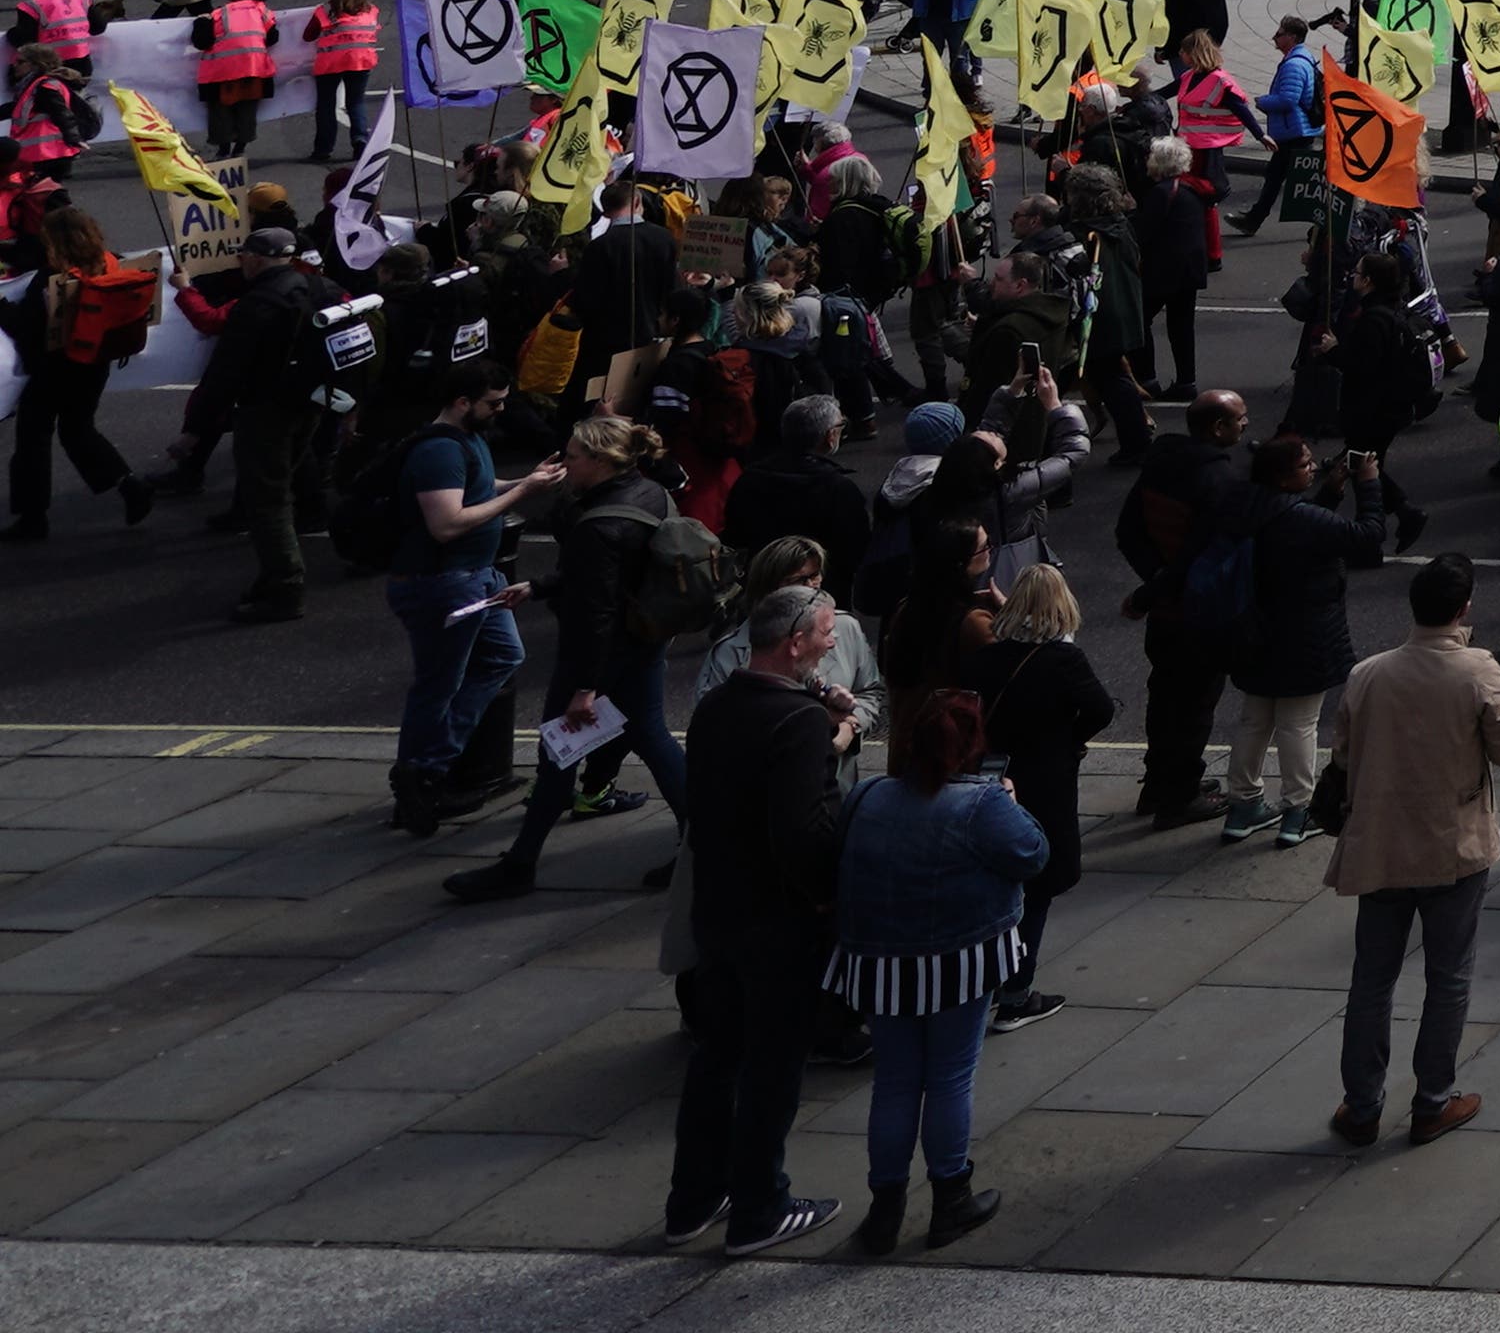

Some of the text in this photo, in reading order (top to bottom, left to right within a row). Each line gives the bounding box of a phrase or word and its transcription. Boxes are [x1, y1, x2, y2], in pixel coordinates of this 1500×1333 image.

[1294, 156, 1321, 170] FOR
[1293, 183, 1347, 217] PLANET
[181, 240, 213, 263] FOR
